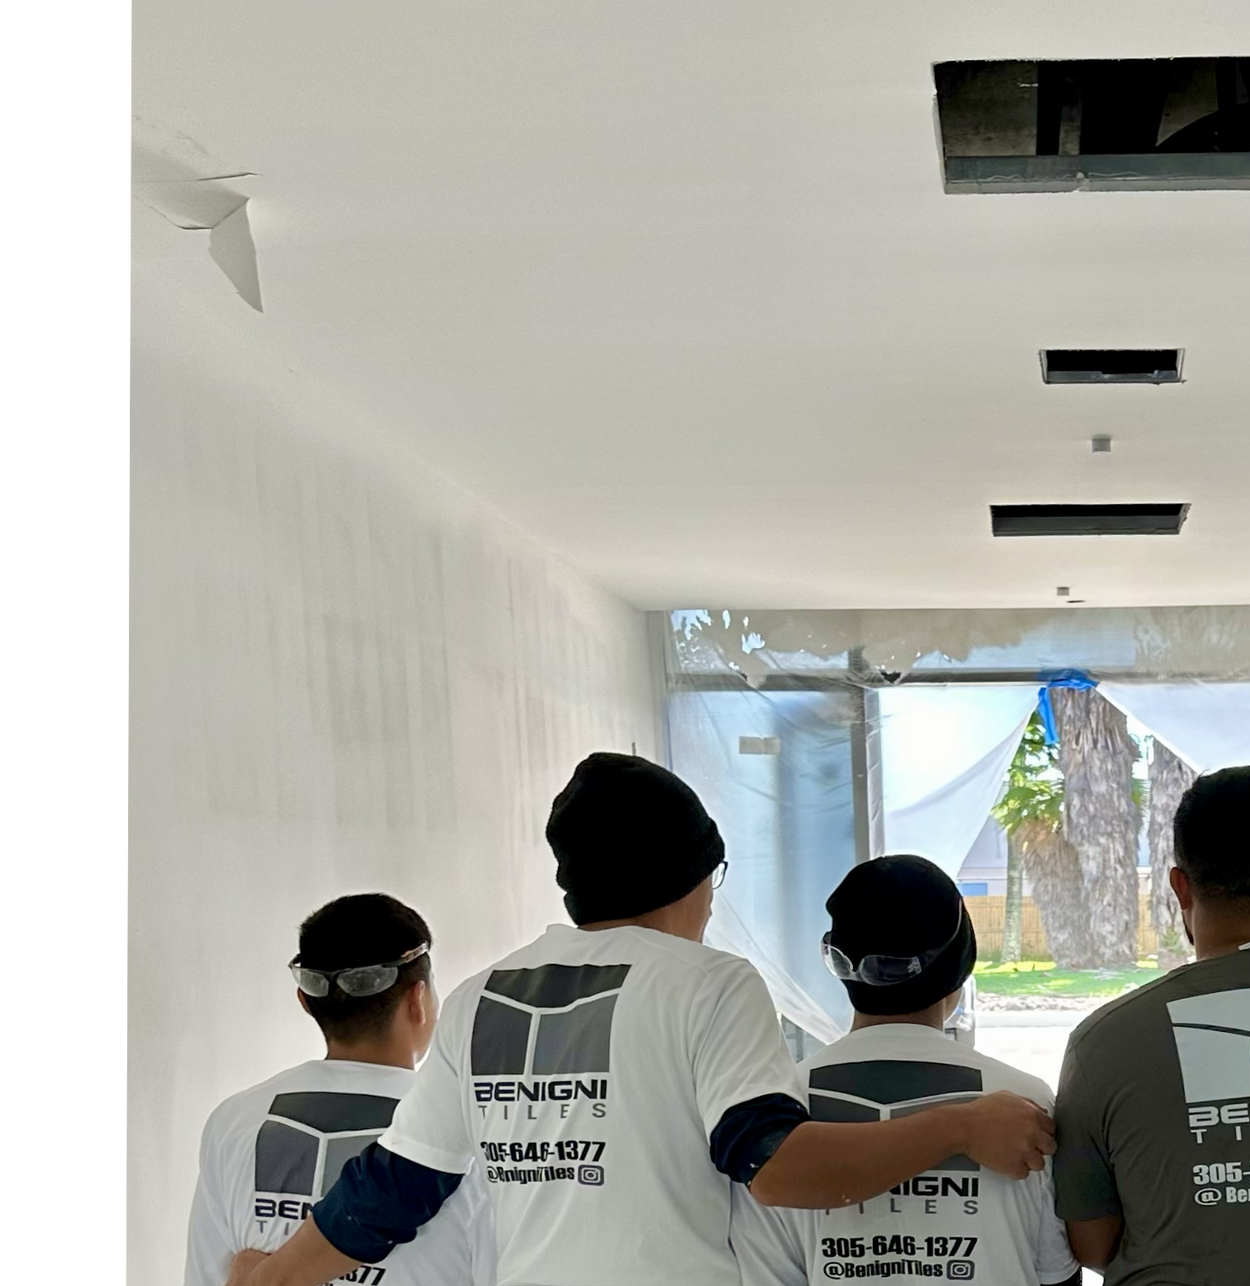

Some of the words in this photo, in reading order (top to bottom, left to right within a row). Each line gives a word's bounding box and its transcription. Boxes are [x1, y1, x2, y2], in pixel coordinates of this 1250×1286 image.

[474, 1079, 608, 1102] BENIGNI
[478, 1103, 607, 1120] TILES
[480, 1140, 607, 1163] 305-646-1377
[889, 1176, 979, 1197] IGNI
[821, 1235, 979, 1259] 305-646-1377
[823, 1259, 944, 1280] @BenigniTiles
